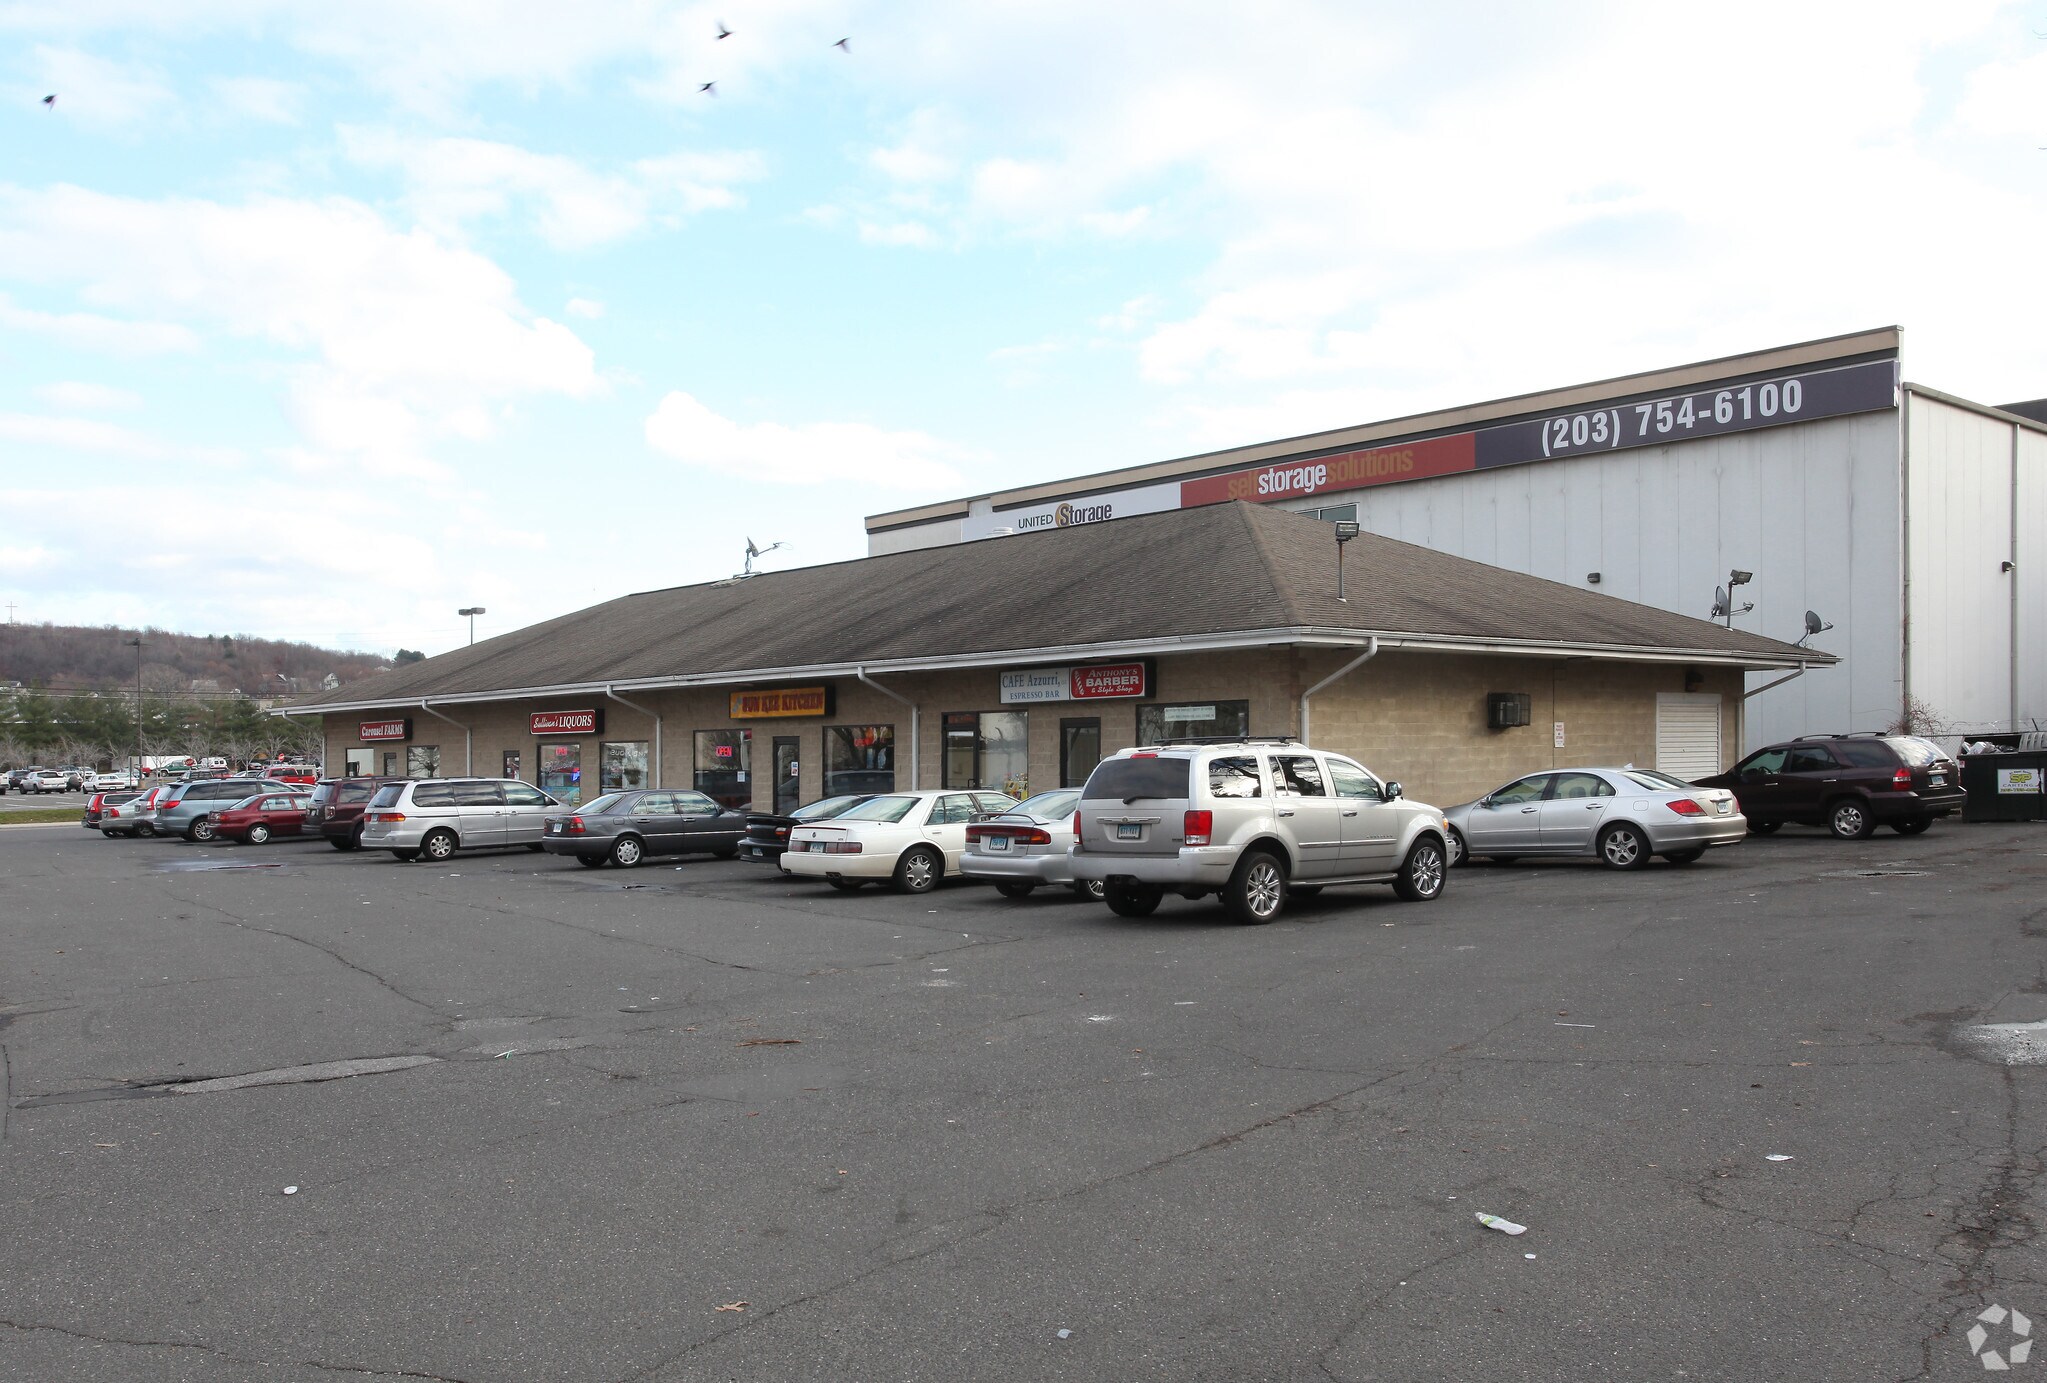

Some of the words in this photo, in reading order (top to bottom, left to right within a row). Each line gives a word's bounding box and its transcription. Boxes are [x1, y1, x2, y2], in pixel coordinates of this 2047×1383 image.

[1542, 409, 1621, 457] (203)
[1635, 379, 1802, 436] 754-6100
[1018, 514, 1053, 528] UNITED
[1060, 504, 1112, 526] Storage
[1002, 674, 1024, 688] CAFE
[1086, 675, 1139, 688] BARBER
[1010, 691, 1042, 700] ESPRESSO
[1046, 690, 1060, 698] BAR
[1116, 685, 1133, 693] Shop
[782, 692, 823, 711] KITCHEN
[559, 715, 592, 728] LIQUORS
[384, 724, 403, 735] FARMS
[715, 745, 732, 757] OPEN
[2009, 774, 2032, 783] SP
